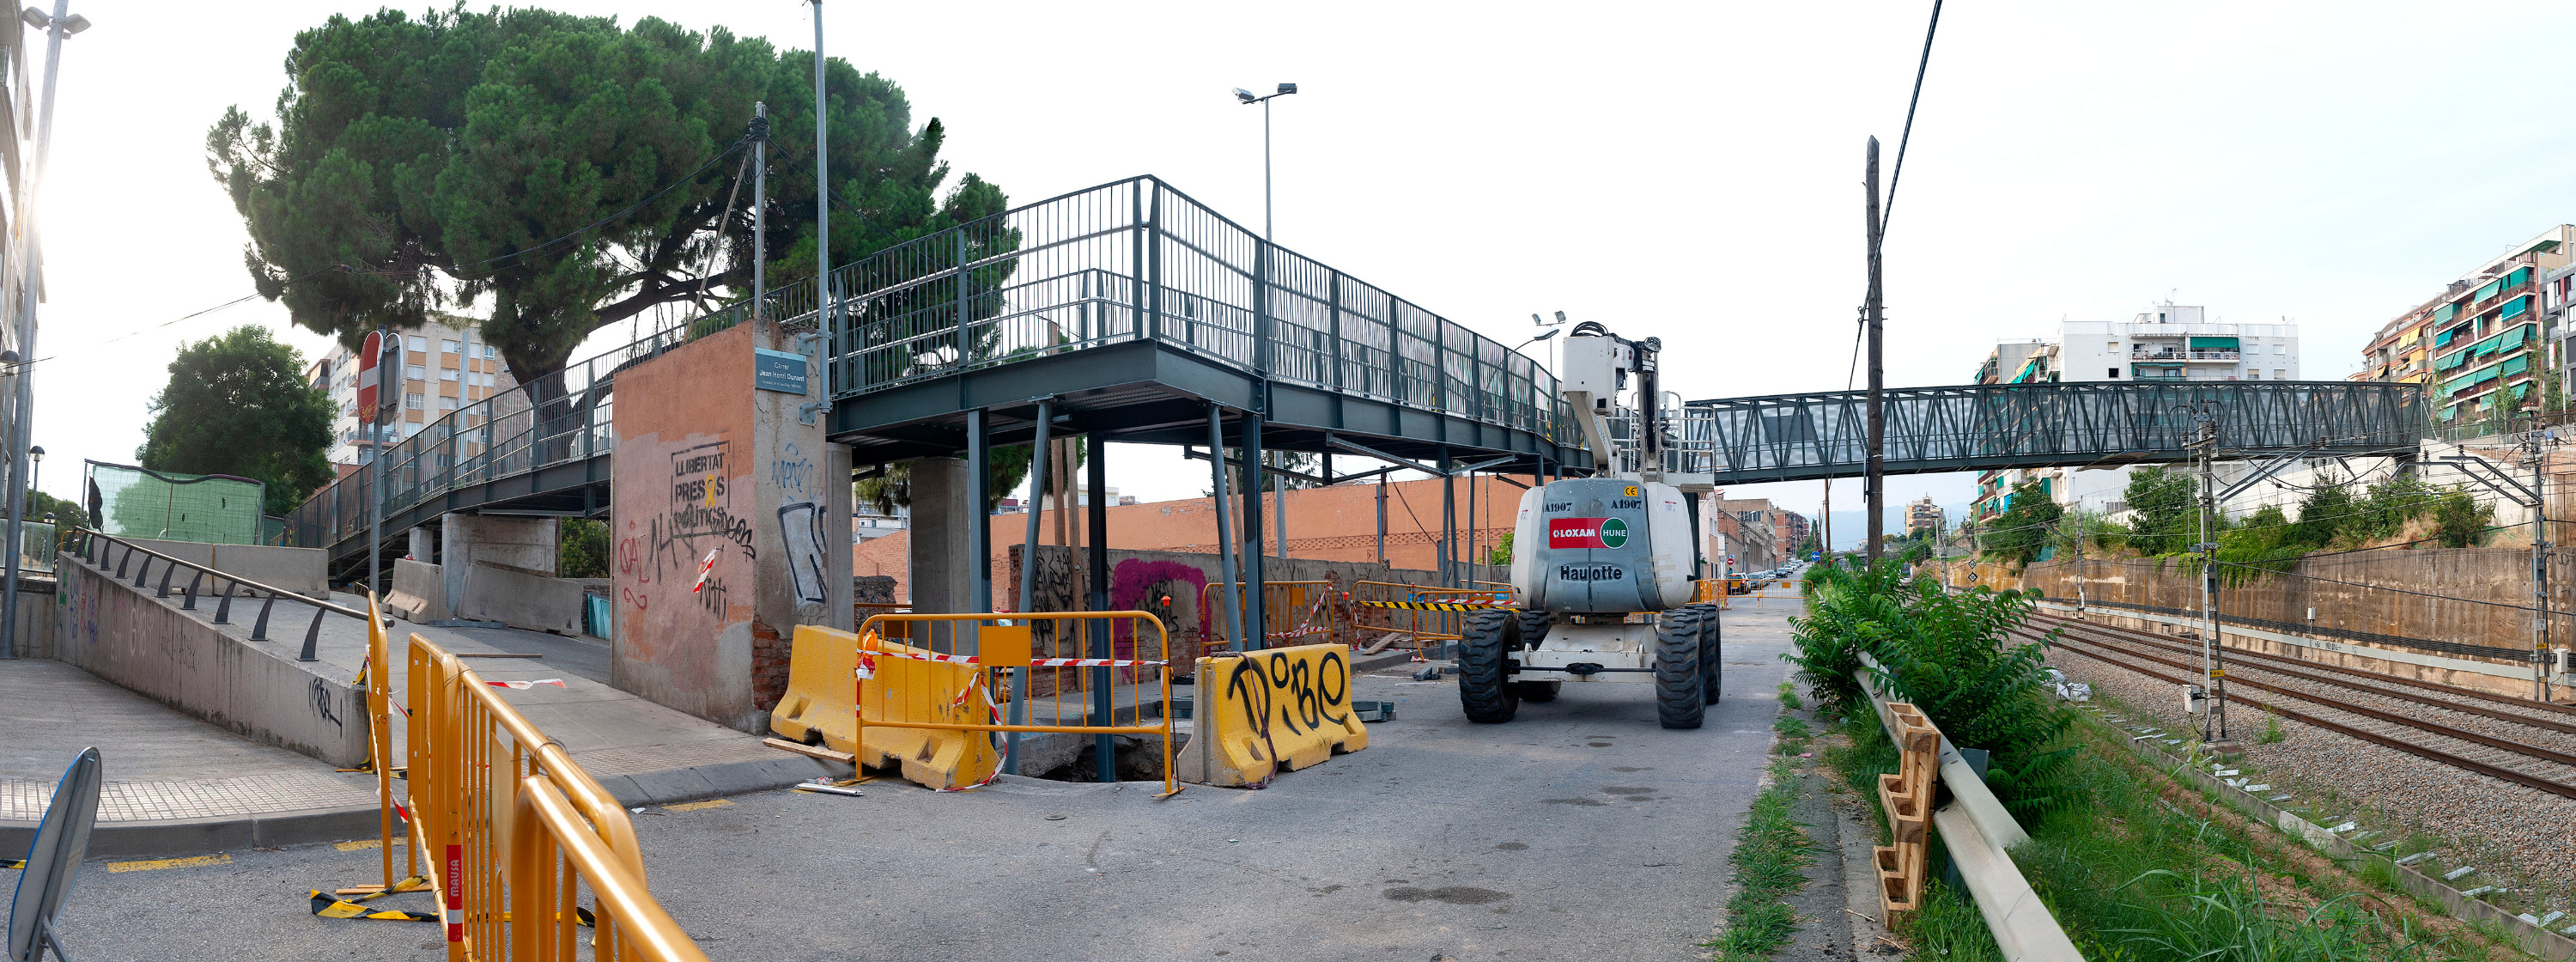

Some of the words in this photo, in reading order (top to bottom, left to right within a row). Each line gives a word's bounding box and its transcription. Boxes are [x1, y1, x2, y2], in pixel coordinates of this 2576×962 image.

[774, 362, 790, 370] Carrer
[787, 373, 805, 382] Dunant
[1545, 502, 1572, 512] A1907
[1611, 499, 1642, 509] A1907
[1560, 528, 1595, 538] LOXAM
[1560, 565, 1623, 581] Haulotte
